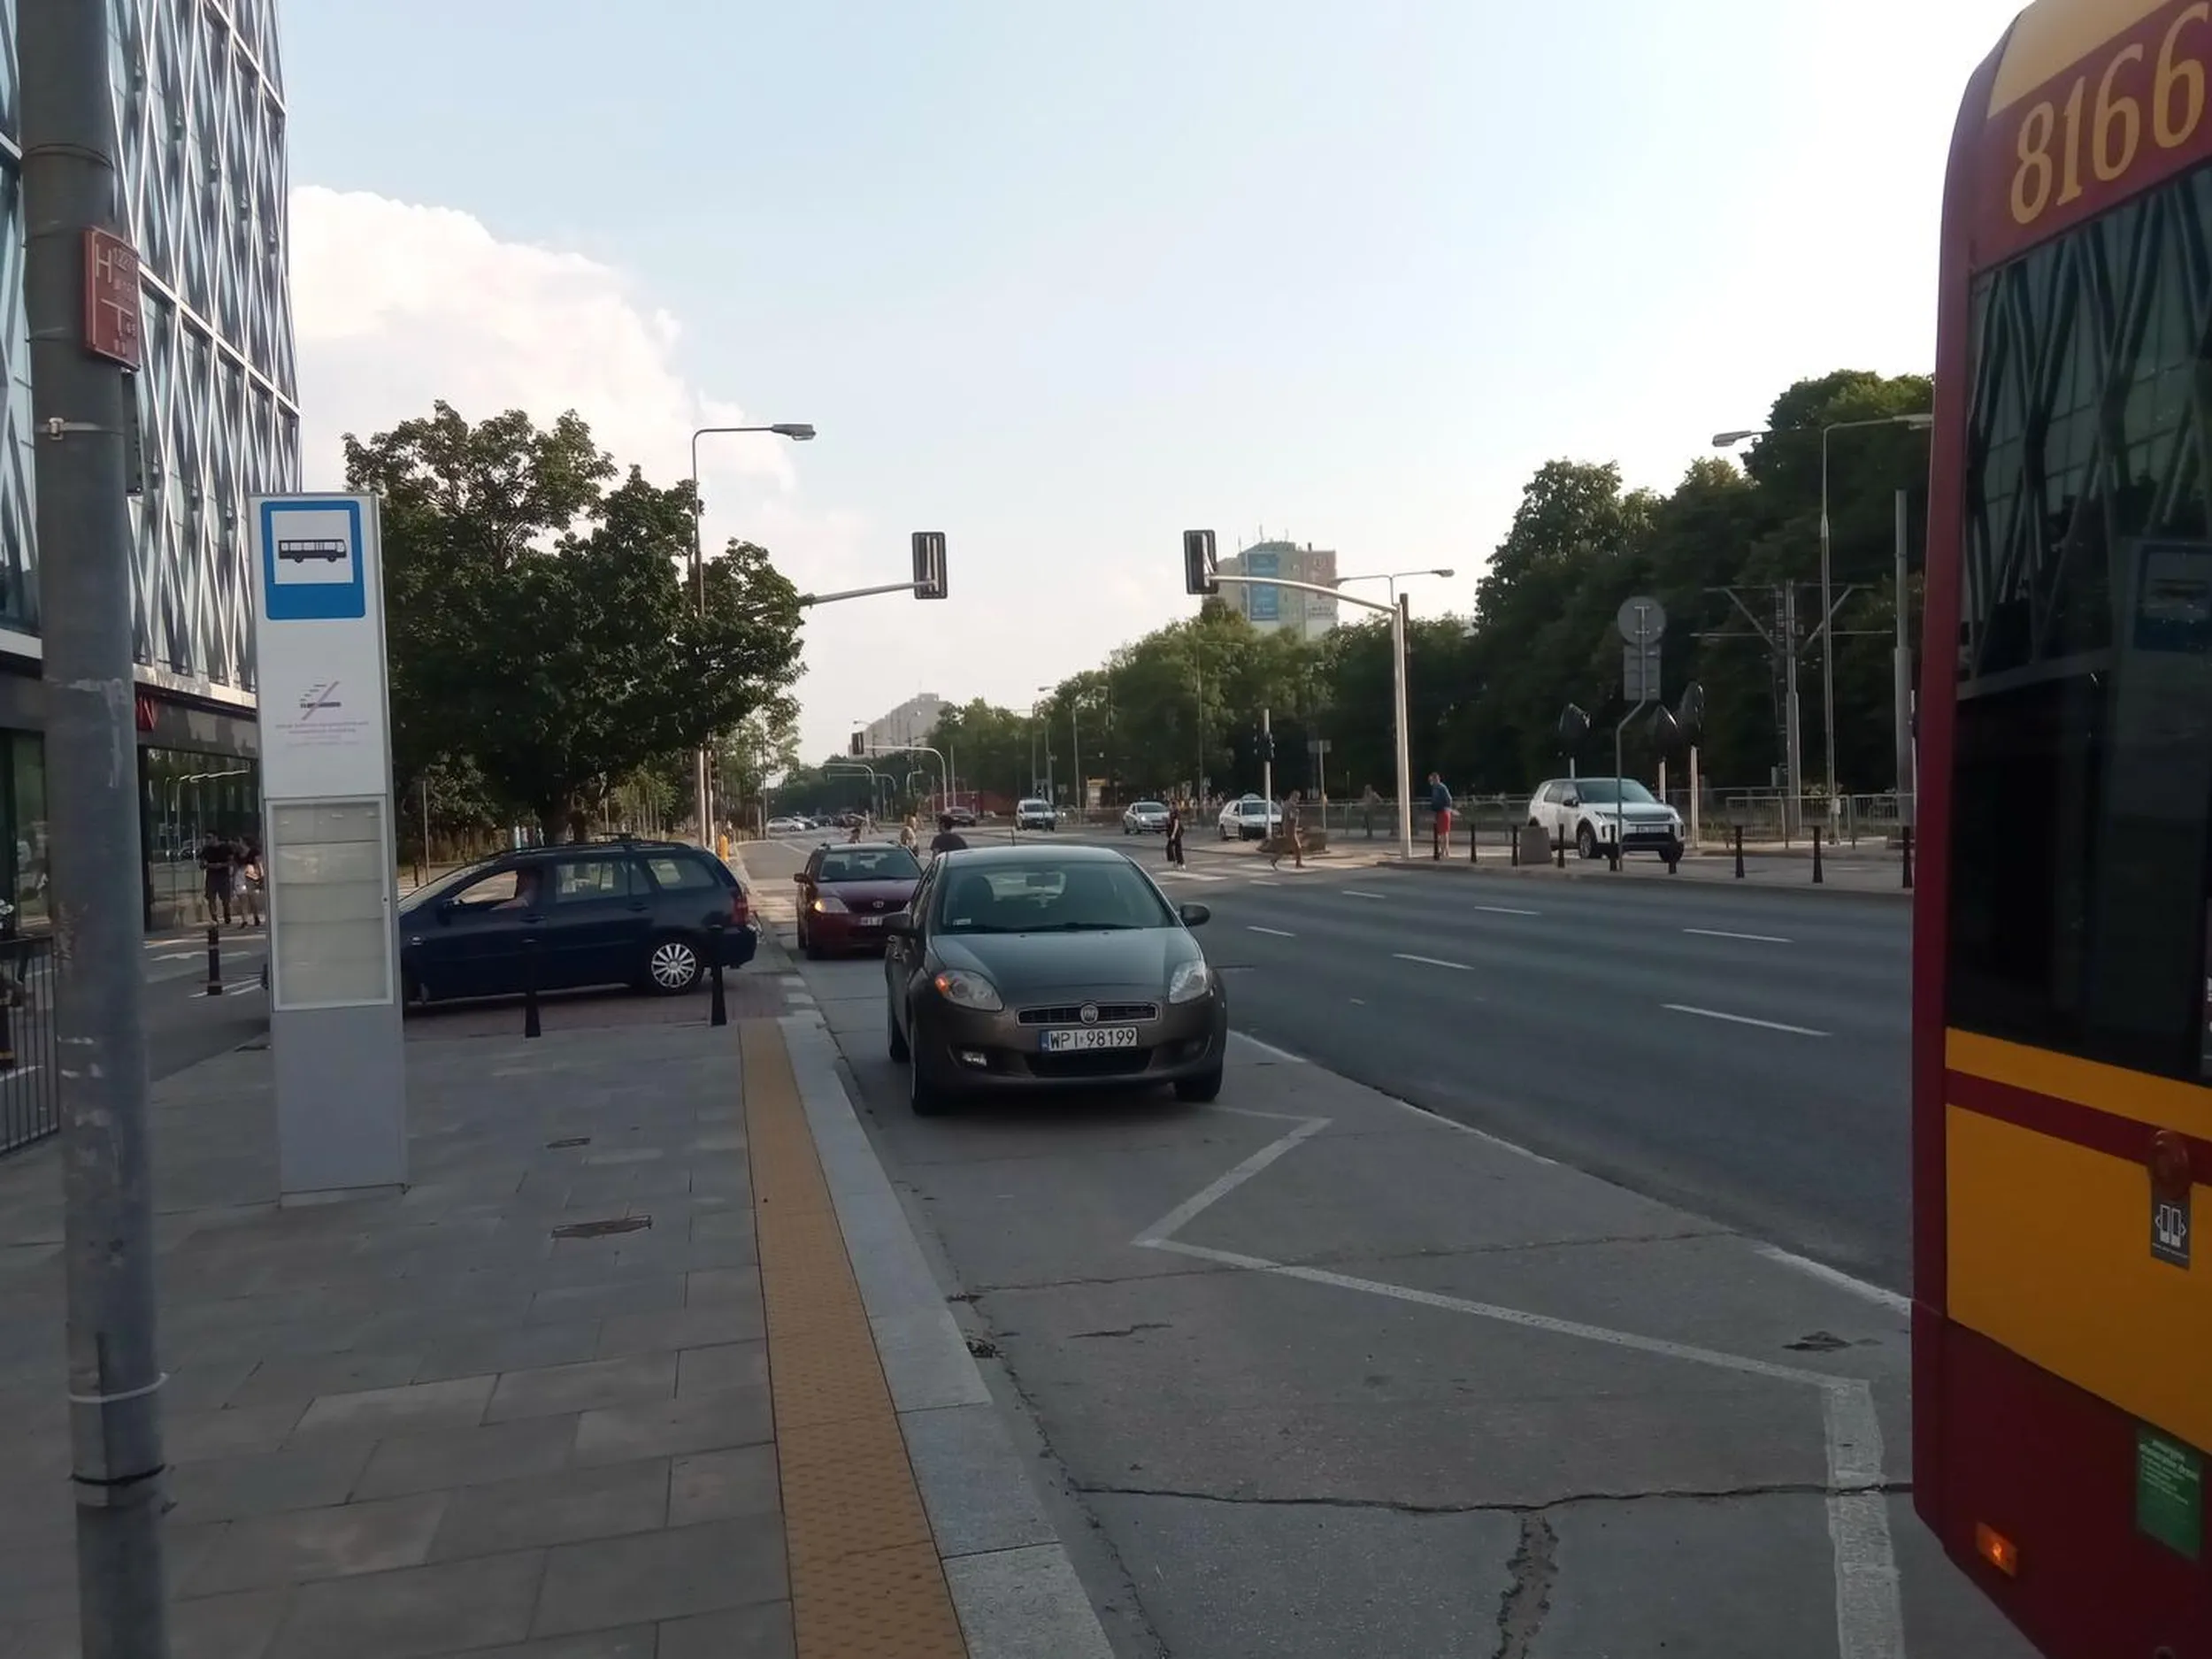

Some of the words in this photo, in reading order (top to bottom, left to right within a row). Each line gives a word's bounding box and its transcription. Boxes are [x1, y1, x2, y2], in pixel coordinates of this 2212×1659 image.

[2010, 2, 2210, 225] 8166
[96, 243, 112, 284] H
[1087, 1029, 1135, 1047] 98199
